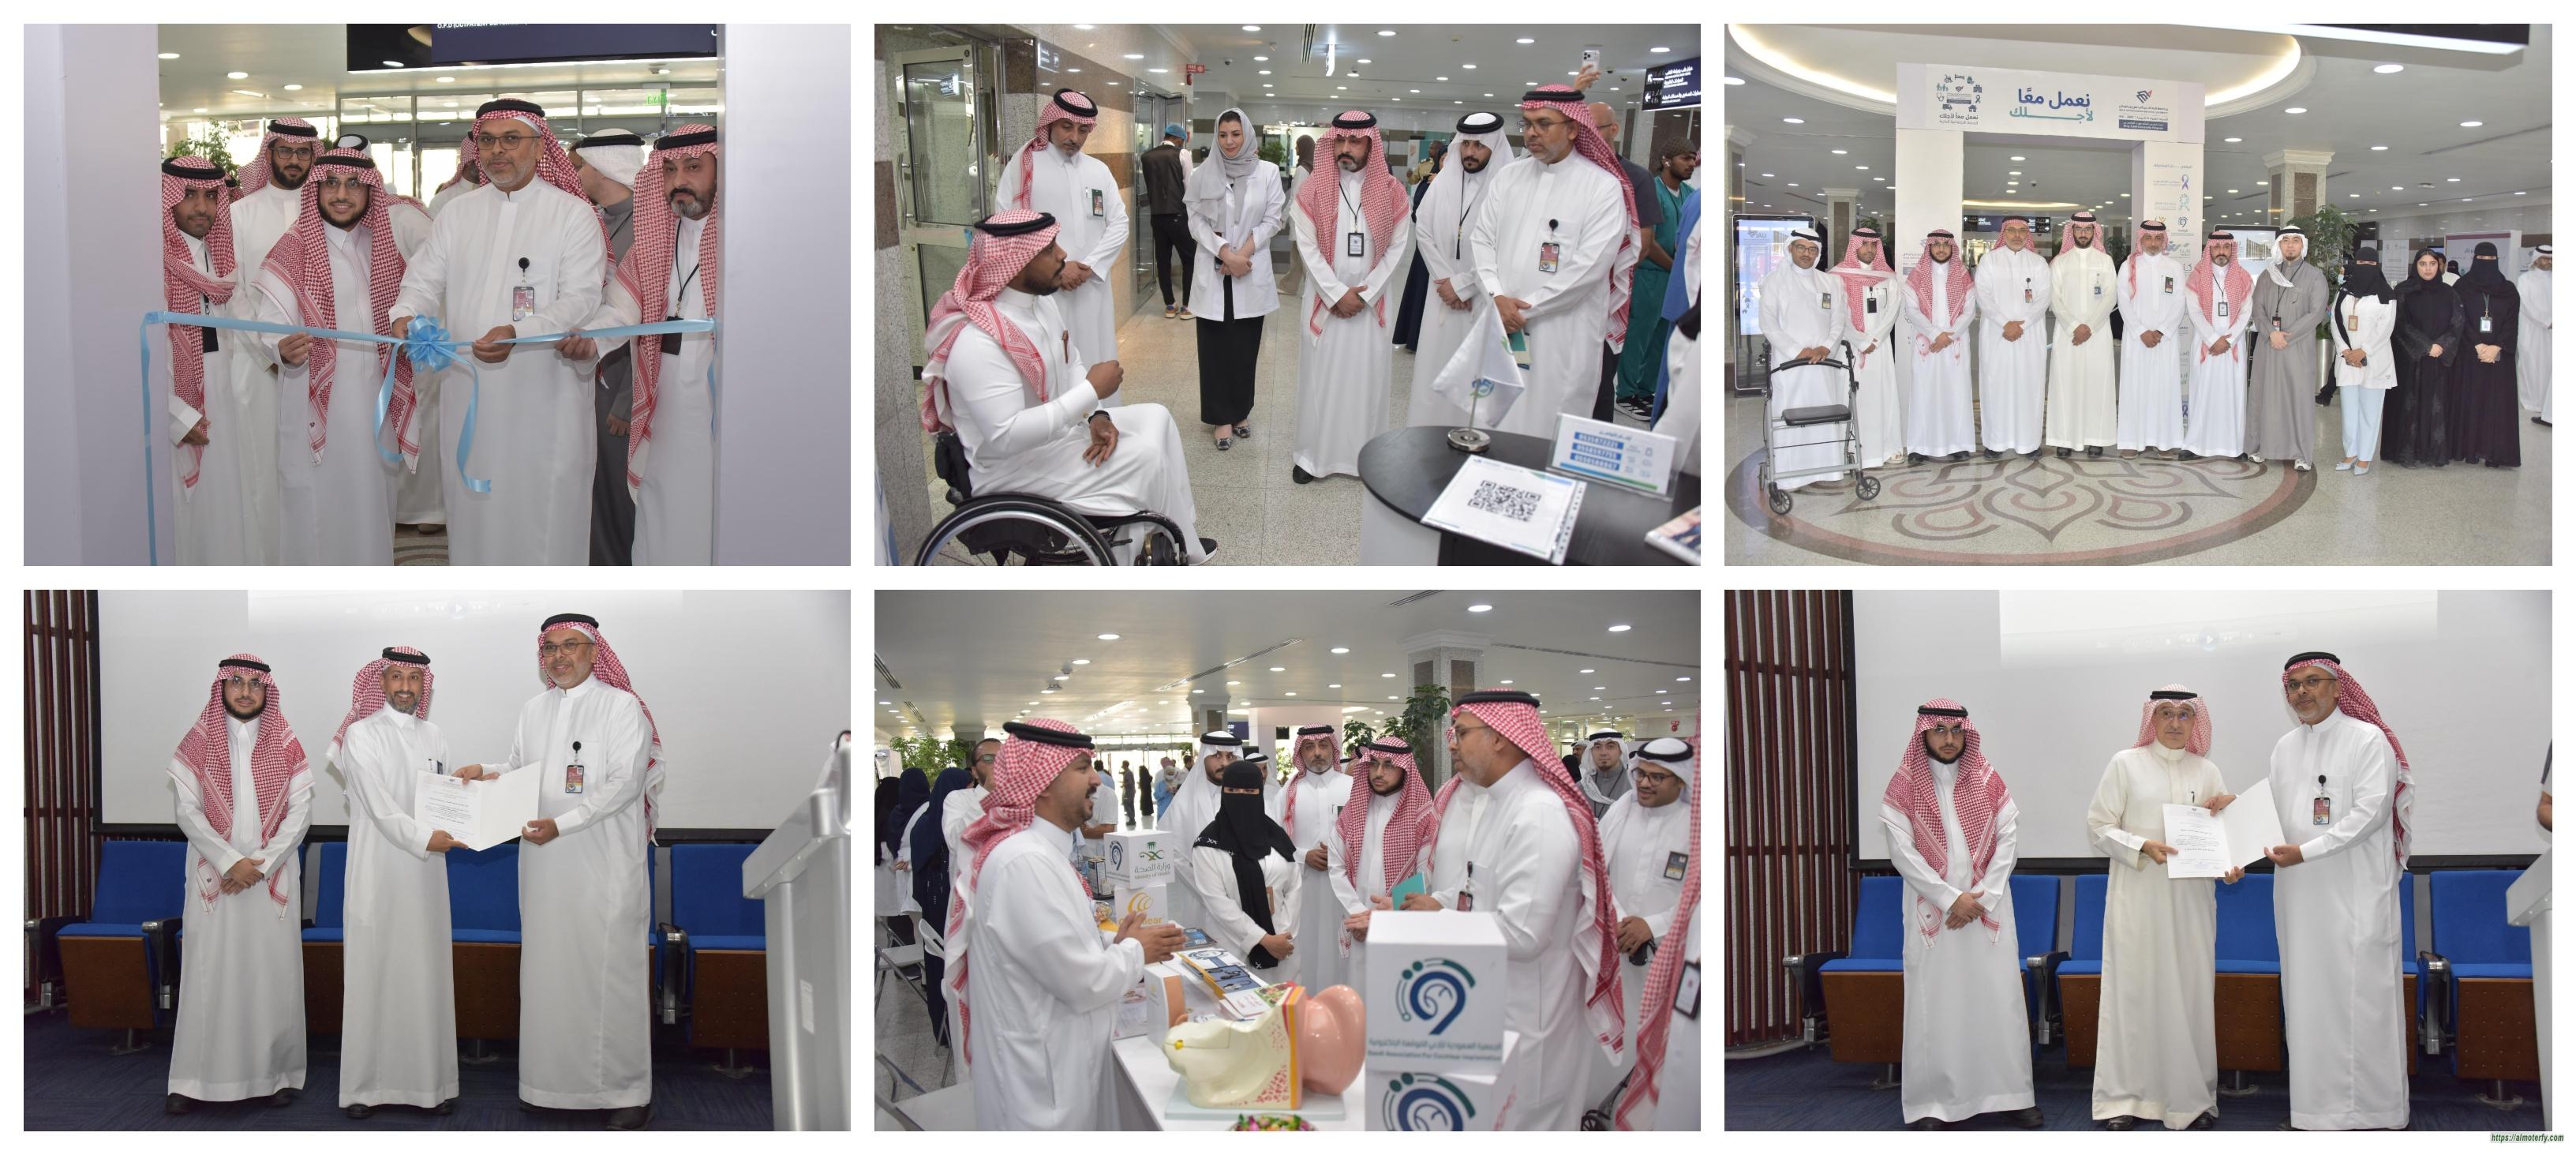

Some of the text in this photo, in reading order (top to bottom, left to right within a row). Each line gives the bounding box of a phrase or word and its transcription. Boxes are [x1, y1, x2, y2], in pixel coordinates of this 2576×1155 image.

[2049, 91, 2091, 109] نعمل
[1135, 862, 1170, 873] وزارة الصحة
